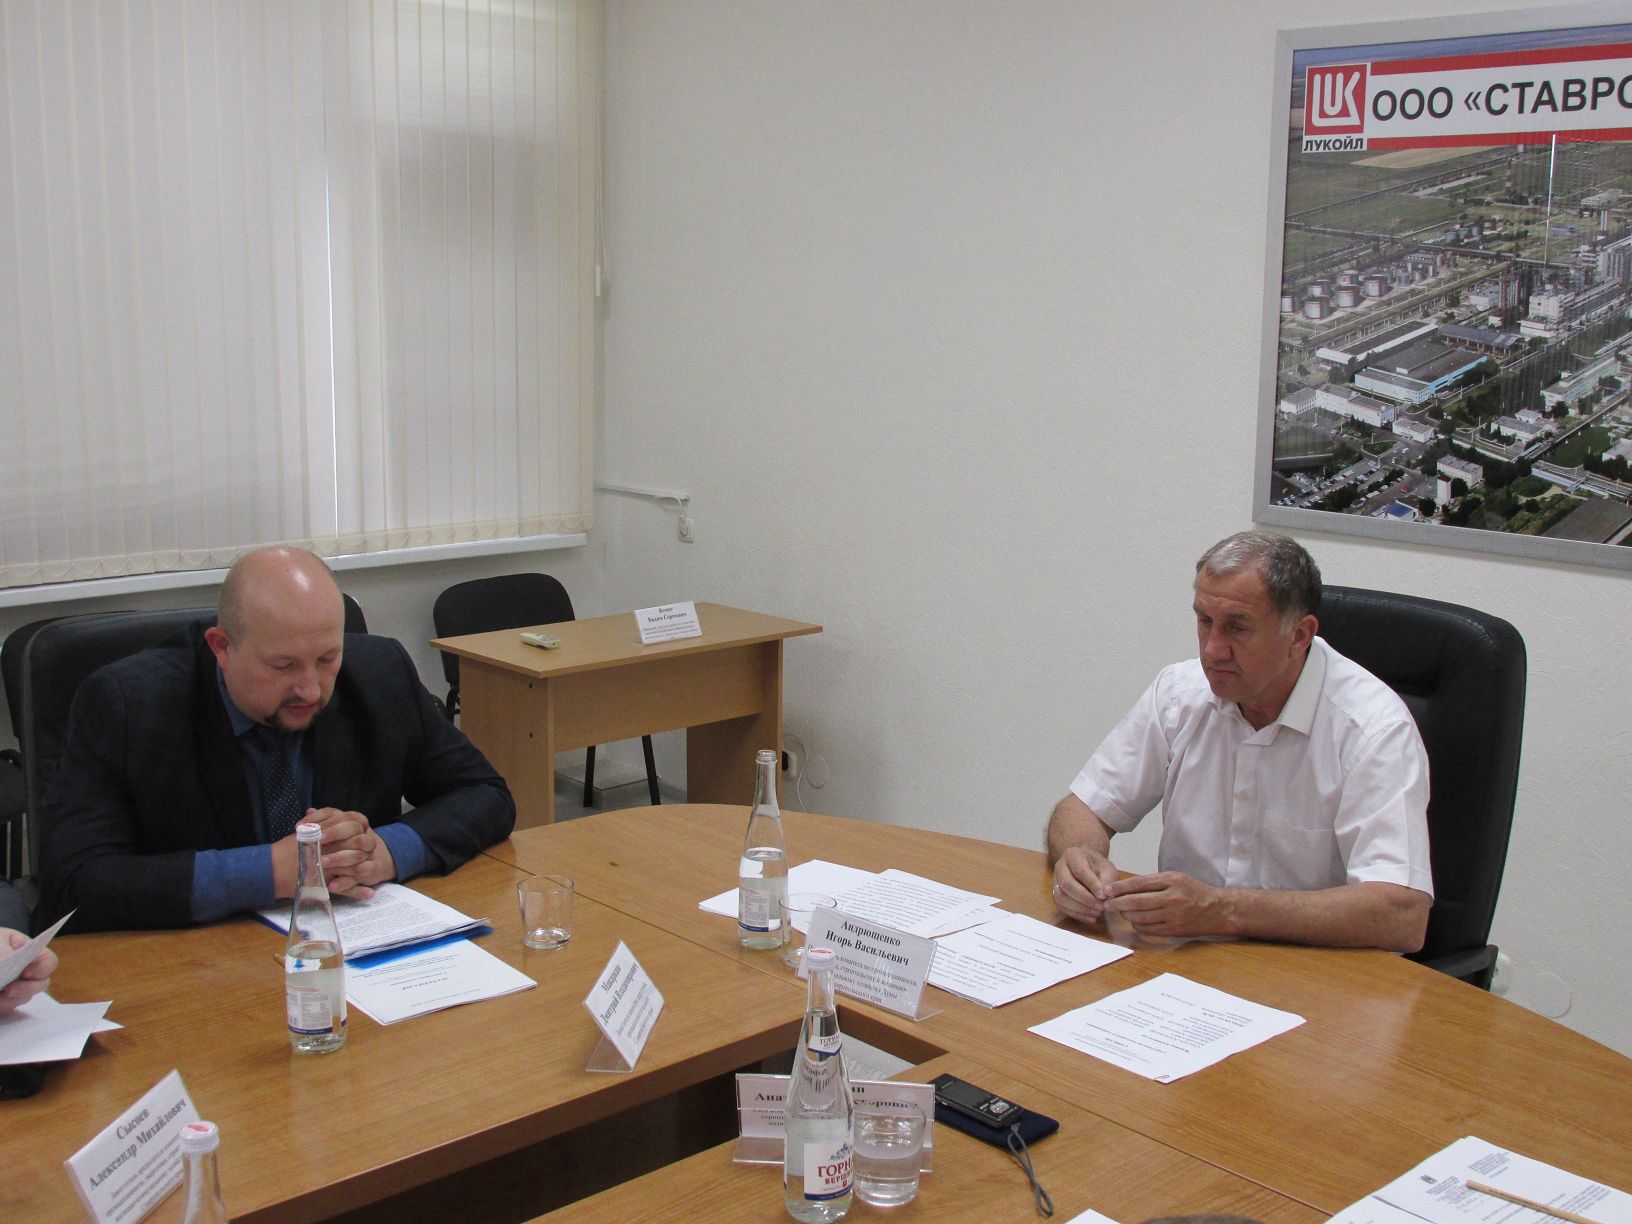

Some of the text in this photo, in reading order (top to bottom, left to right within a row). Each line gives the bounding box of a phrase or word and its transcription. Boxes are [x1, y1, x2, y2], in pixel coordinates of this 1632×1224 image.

[1371, 86, 1454, 121] ООО
[1304, 136, 1364, 152] ЛУКОЙЛ
[825, 930, 910, 967] Игорь Васильевич
[116, 1108, 150, 1140] Сысоев
[89, 1098, 187, 1191] Александр Михайлович
